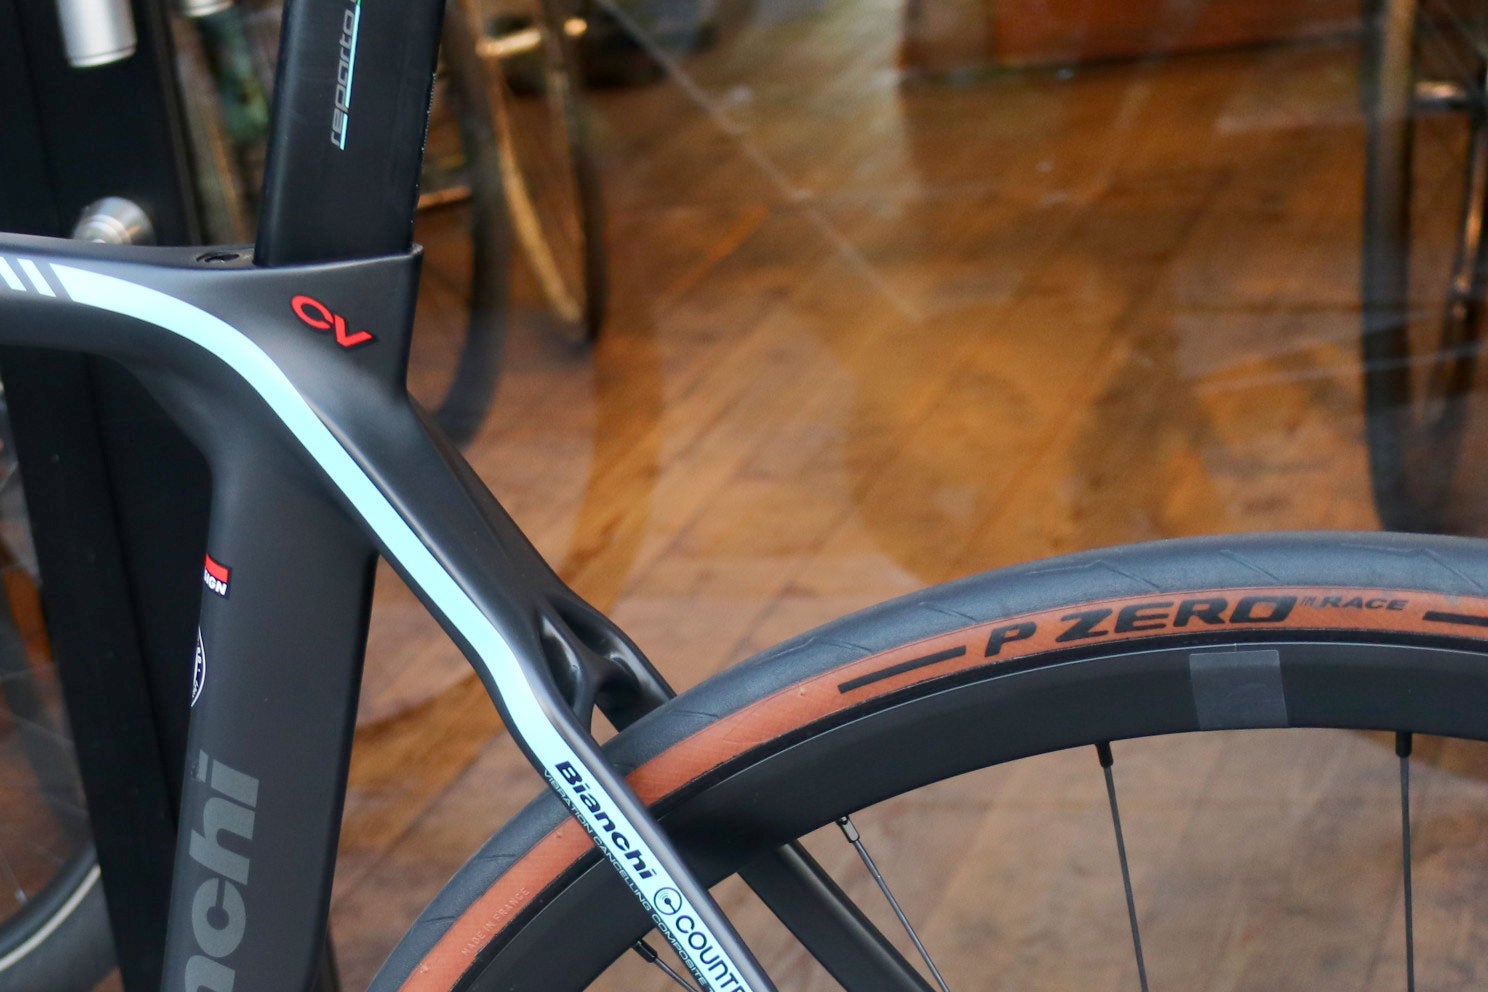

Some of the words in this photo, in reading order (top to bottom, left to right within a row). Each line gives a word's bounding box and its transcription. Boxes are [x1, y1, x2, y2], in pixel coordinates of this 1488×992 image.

[330, 9, 354, 148] reparto
[290, 293, 374, 348] CV
[984, 621, 1038, 658] P
[1055, 595, 1299, 643] ZERO
[1320, 596, 1409, 611] RACE
[555, 761, 657, 880] Bianchi
[544, 768, 593, 834] VIBRATION
[593, 835, 652, 912] CANCELLING
[651, 913, 707, 986] COMPOSITE
[460, 931, 486, 956] MADE
